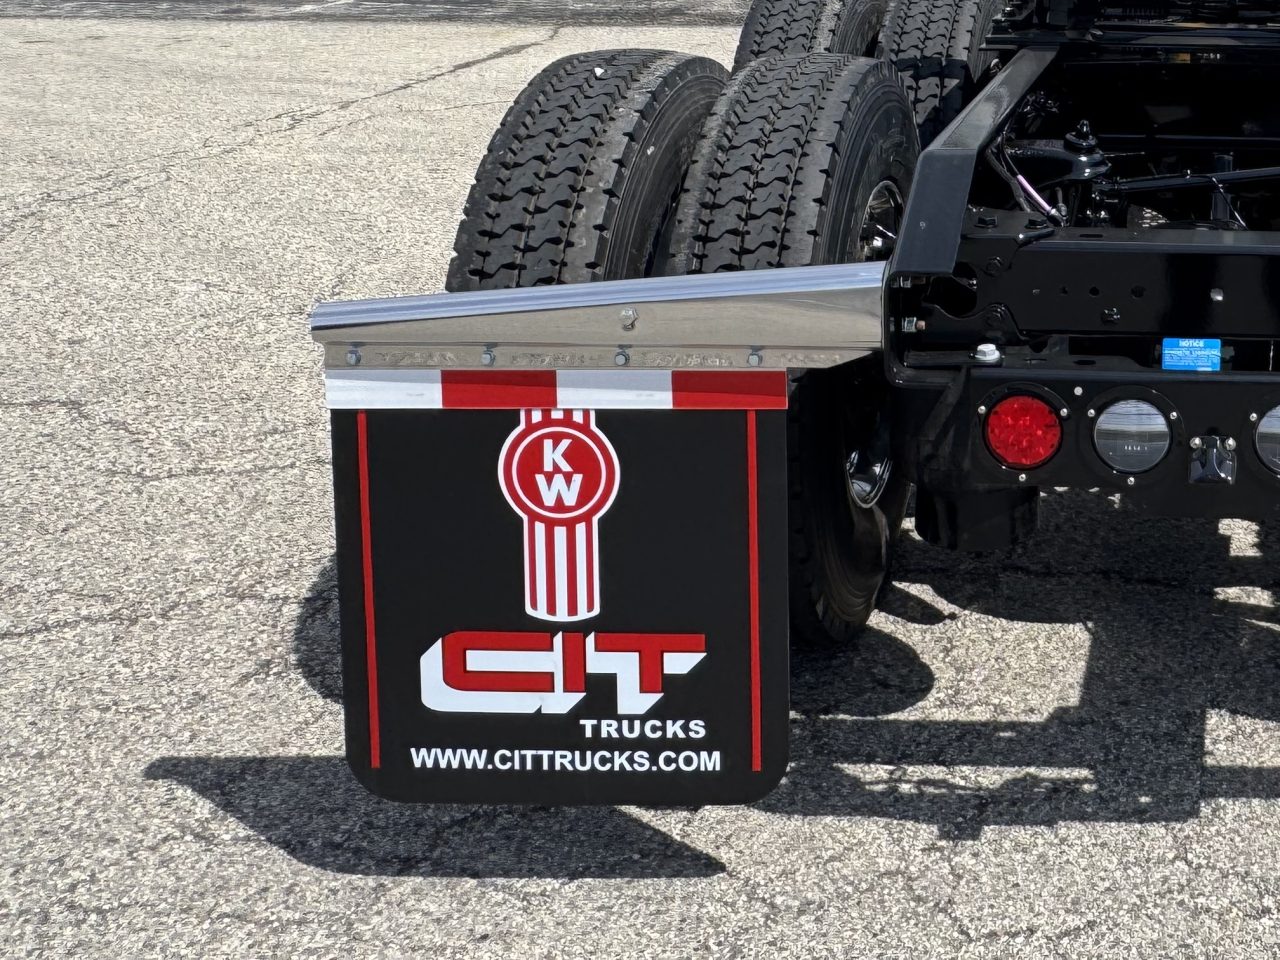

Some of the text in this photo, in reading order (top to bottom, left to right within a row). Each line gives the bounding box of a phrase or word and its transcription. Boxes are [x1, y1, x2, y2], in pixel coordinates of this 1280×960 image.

[542, 438, 573, 472] K
[535, 473, 583, 507] W
[420, 630, 707, 714] CIT
[579, 719, 707, 739] TRUCKS
[410, 747, 722, 772] WWW.CITTRUCKS.COM
